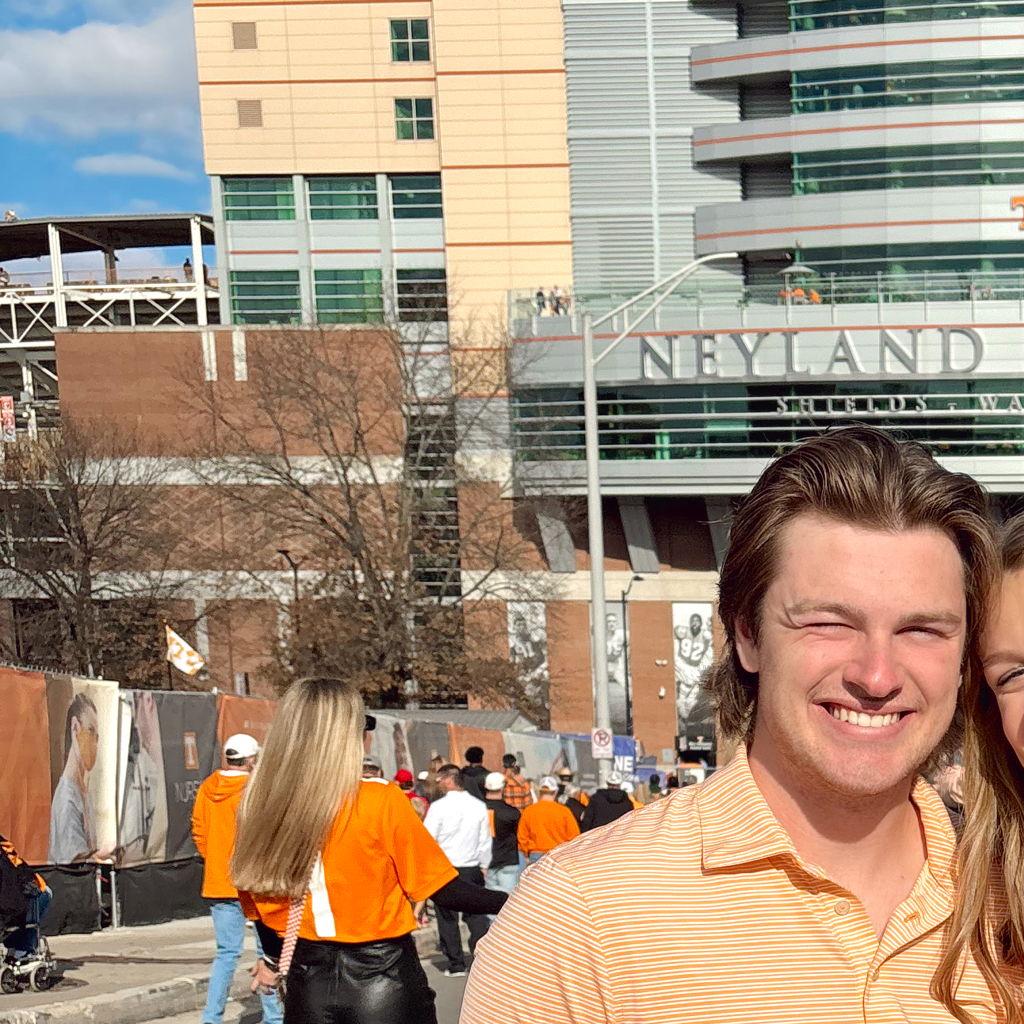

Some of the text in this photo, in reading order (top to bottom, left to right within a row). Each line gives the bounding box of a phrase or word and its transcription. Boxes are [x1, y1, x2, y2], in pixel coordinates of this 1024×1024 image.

[639, 327, 985, 379] NEYLAND
[776, 395, 927, 415] SHIELDS
[681, 638, 705, 661] 92
